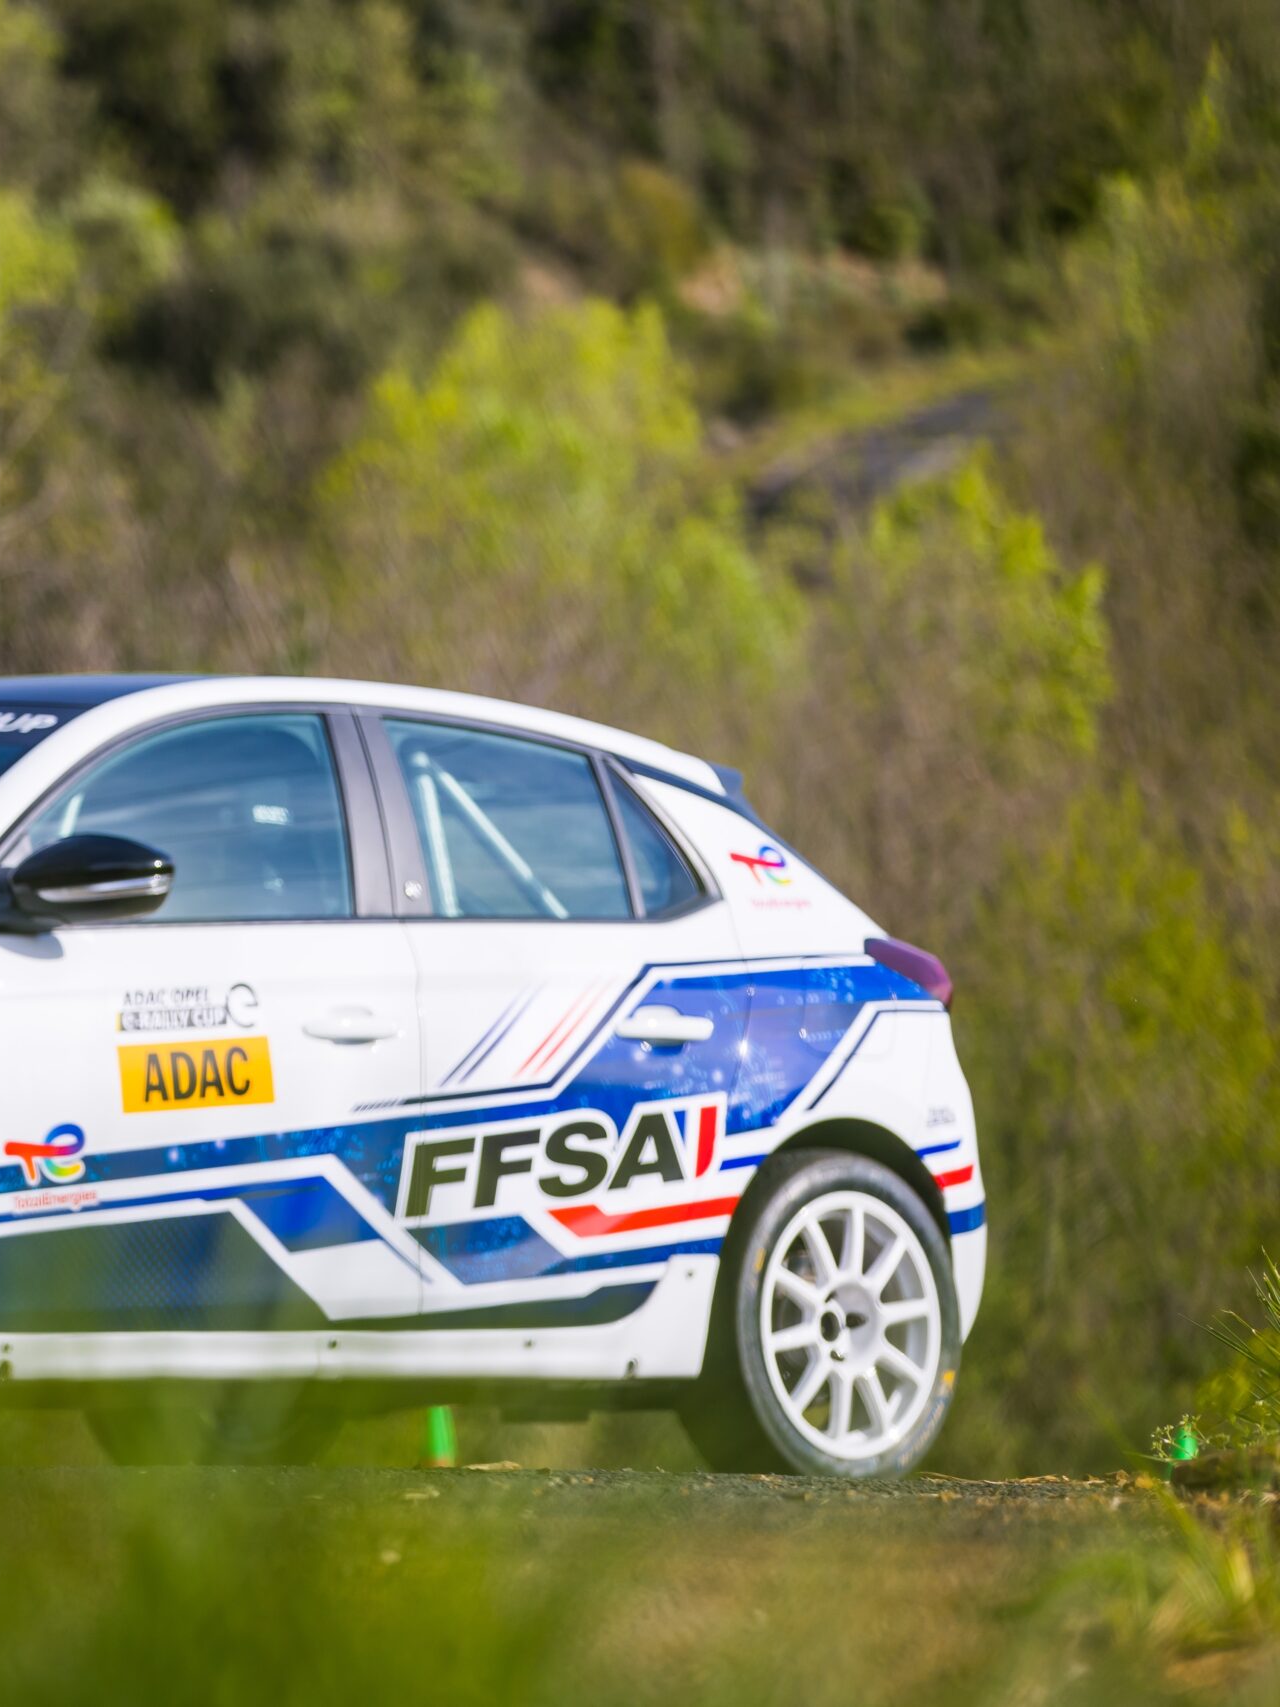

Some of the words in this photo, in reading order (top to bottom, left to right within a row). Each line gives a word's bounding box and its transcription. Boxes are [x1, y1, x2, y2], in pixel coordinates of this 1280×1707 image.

[123, 988, 166, 1007] ADAC
[144, 1046, 252, 1103] ADAC
[405, 1111, 686, 1218] FFSA
